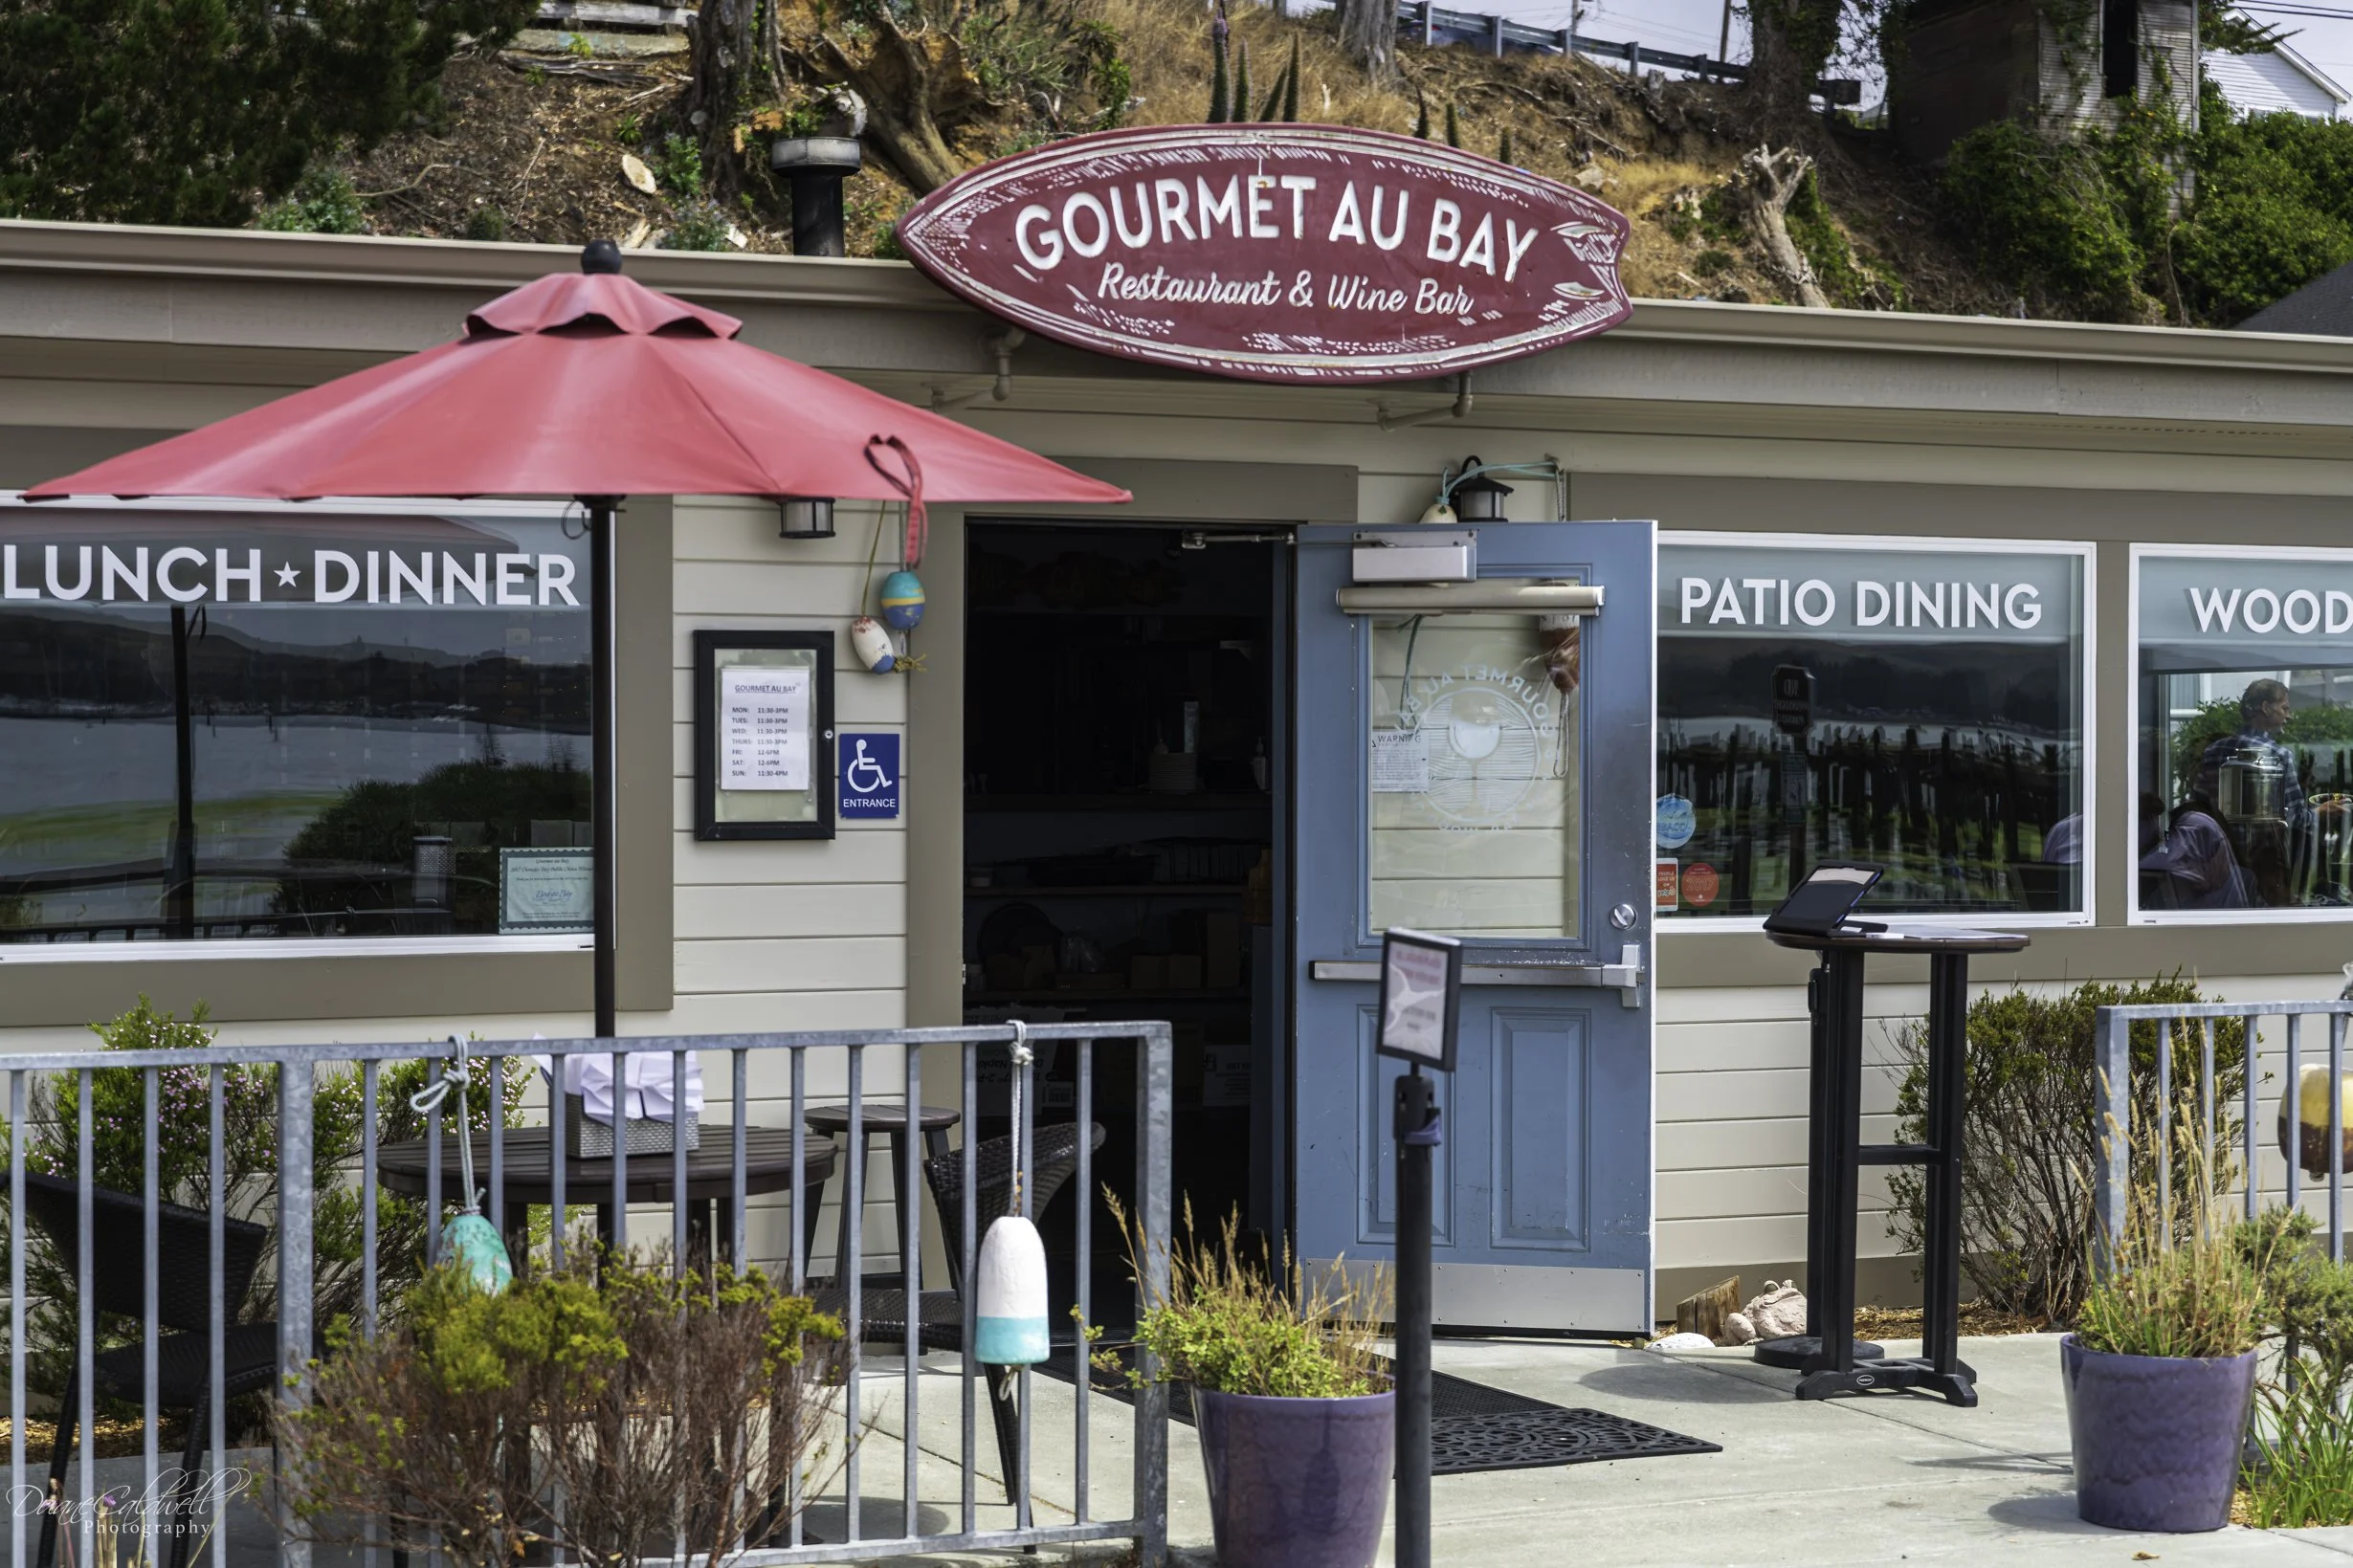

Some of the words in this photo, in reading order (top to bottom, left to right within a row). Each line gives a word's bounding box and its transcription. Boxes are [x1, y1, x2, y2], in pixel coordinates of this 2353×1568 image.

[1014, 173, 1318, 271] GOURMET
[1328, 180, 1410, 253] AU
[1427, 197, 1539, 283] BAY
[1098, 260, 1283, 307] Restaurant
[1288, 270, 1315, 308] &
[1328, 273, 1410, 315] Wine
[1415, 277, 1476, 317] Bar
[3, 543, 262, 603] LUNCH
[313, 549, 582, 607] DINNER
[1679, 577, 1836, 627] PATIO
[1855, 580, 2043, 629] DINING
[2189, 585, 2353, 635] WOOD
[734, 685, 770, 694] GOURMET
[771, 685, 782, 694] AU
[843, 798, 896, 808] ENTRANCE
[1686, 878, 1716, 892] 2017
